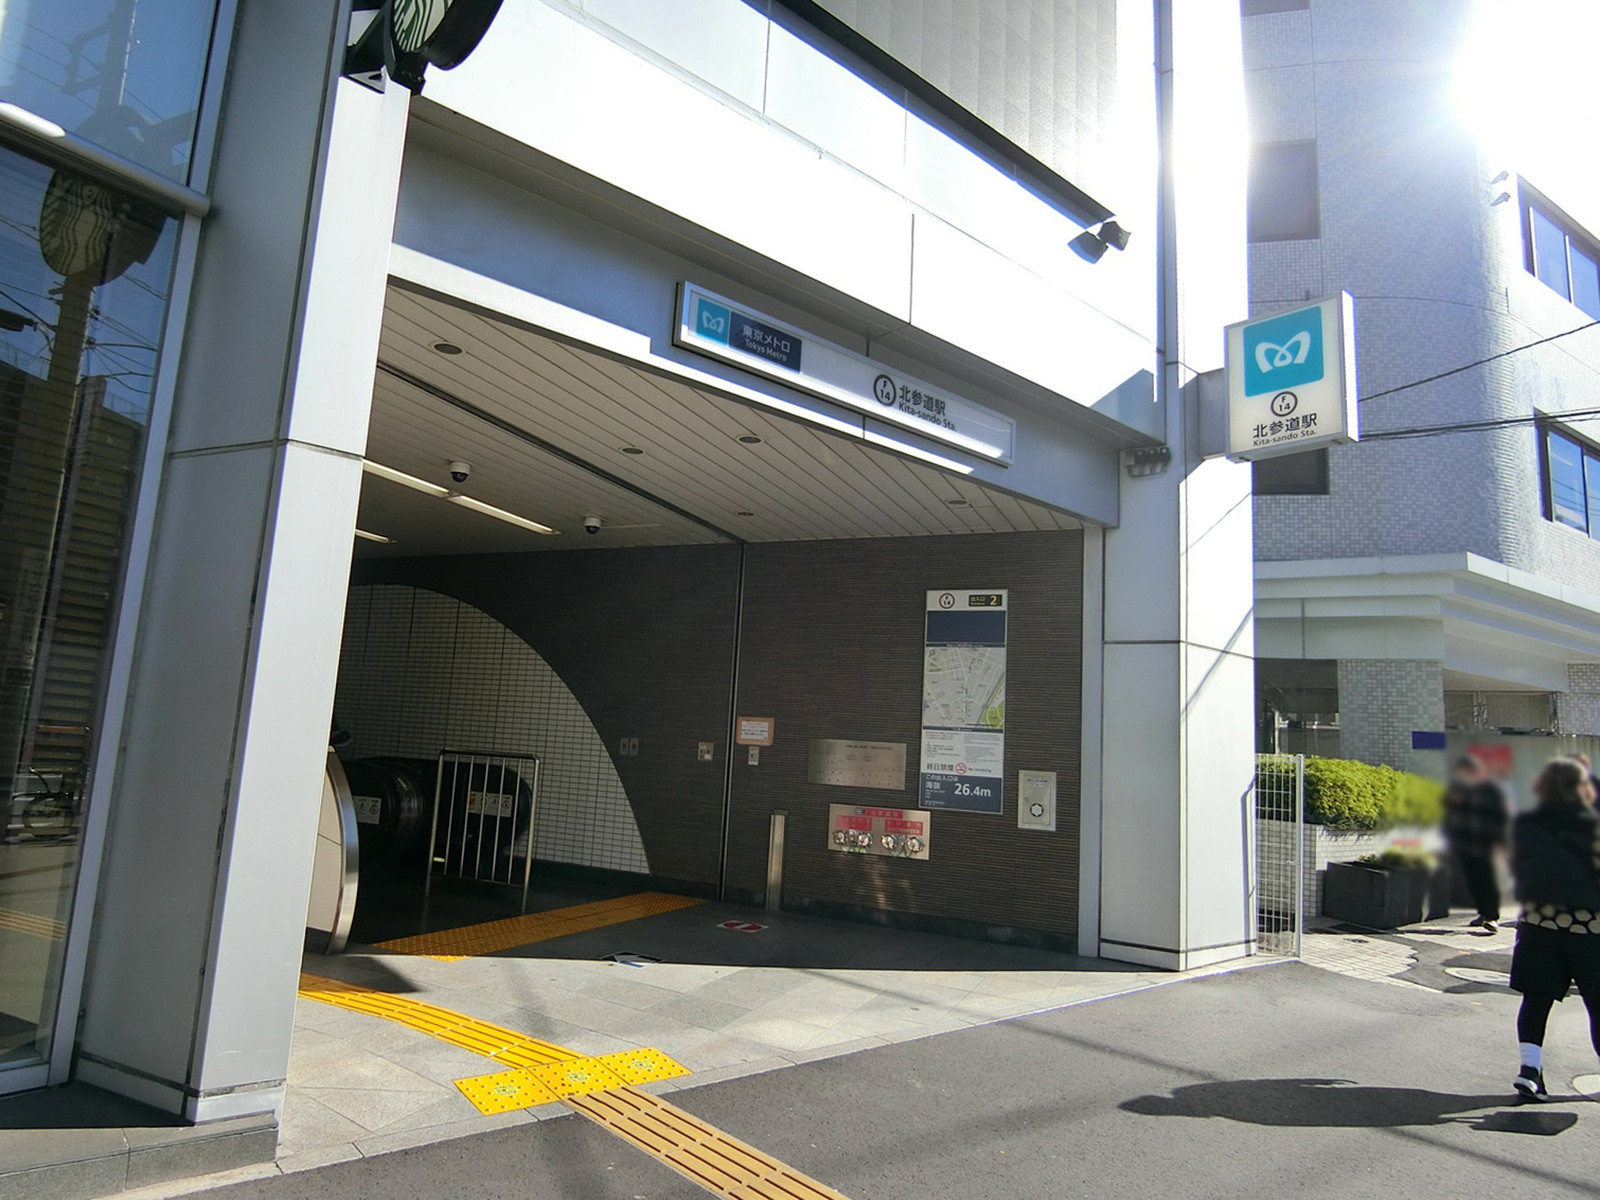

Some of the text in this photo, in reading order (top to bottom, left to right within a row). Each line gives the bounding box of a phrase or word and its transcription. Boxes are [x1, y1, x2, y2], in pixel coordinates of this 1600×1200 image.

[742, 324, 791, 353] 東京メトロ
[743, 338, 788, 362] Tokyo Metro
[882, 380, 888, 389] F
[880, 388, 891, 402] 14
[898, 384, 946, 417] 北参道駅
[1278, 402, 1291, 412] 14
[898, 400, 958, 432] Kita-sando Sta.
[1252, 412, 1318, 439] 北参道駅
[1252, 429, 1318, 447] Kita-sando Sta.
[989, 594, 998, 606] 2
[925, 774, 959, 782] この出入口は
[954, 782, 992, 798] 26.4m
